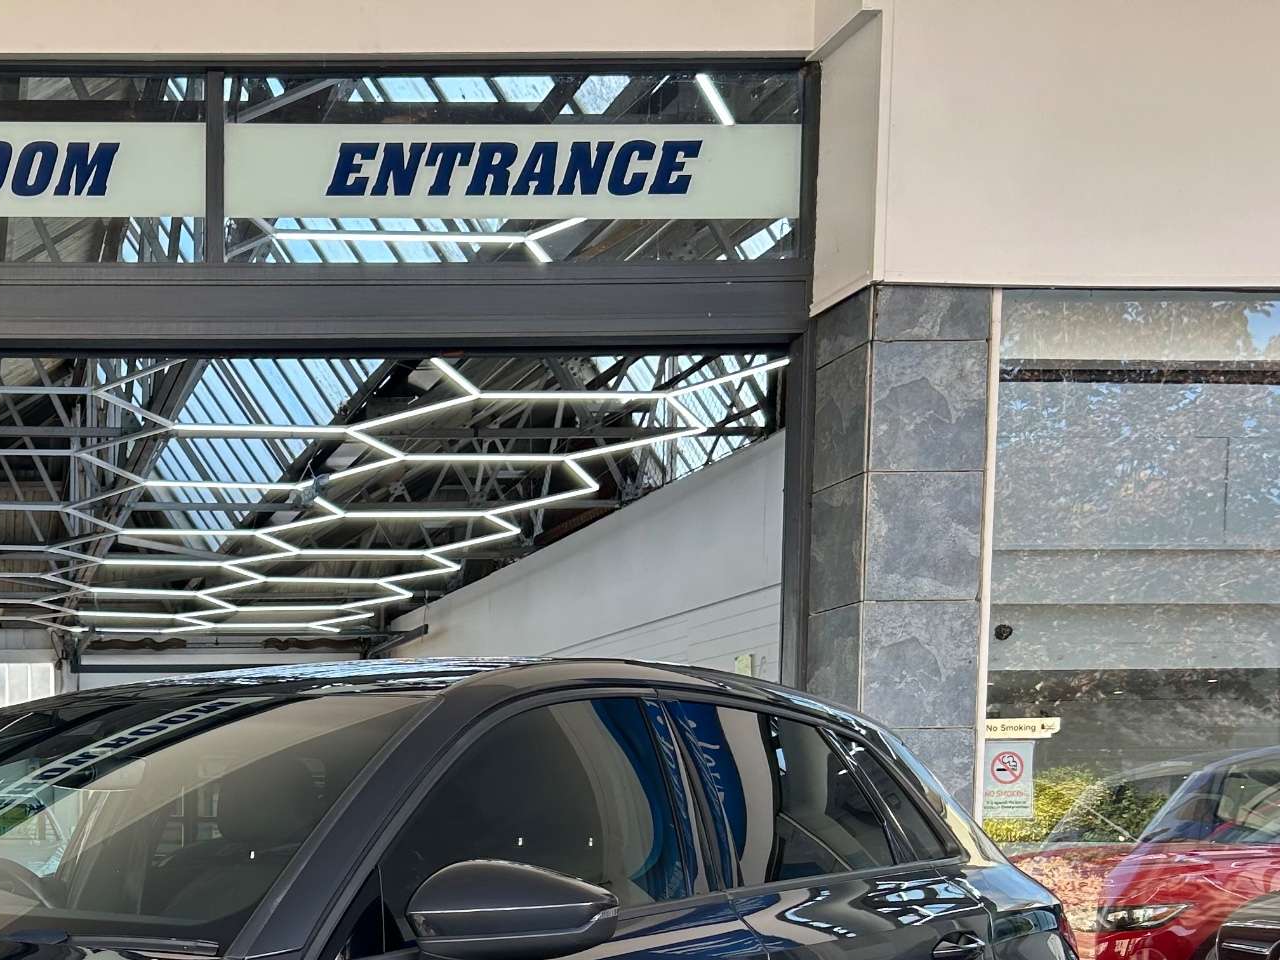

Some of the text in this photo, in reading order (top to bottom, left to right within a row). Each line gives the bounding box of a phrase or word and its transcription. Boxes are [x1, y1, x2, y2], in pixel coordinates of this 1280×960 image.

[325, 139, 704, 197] ENTRANCE
[985, 724, 1037, 733] No Smoking
